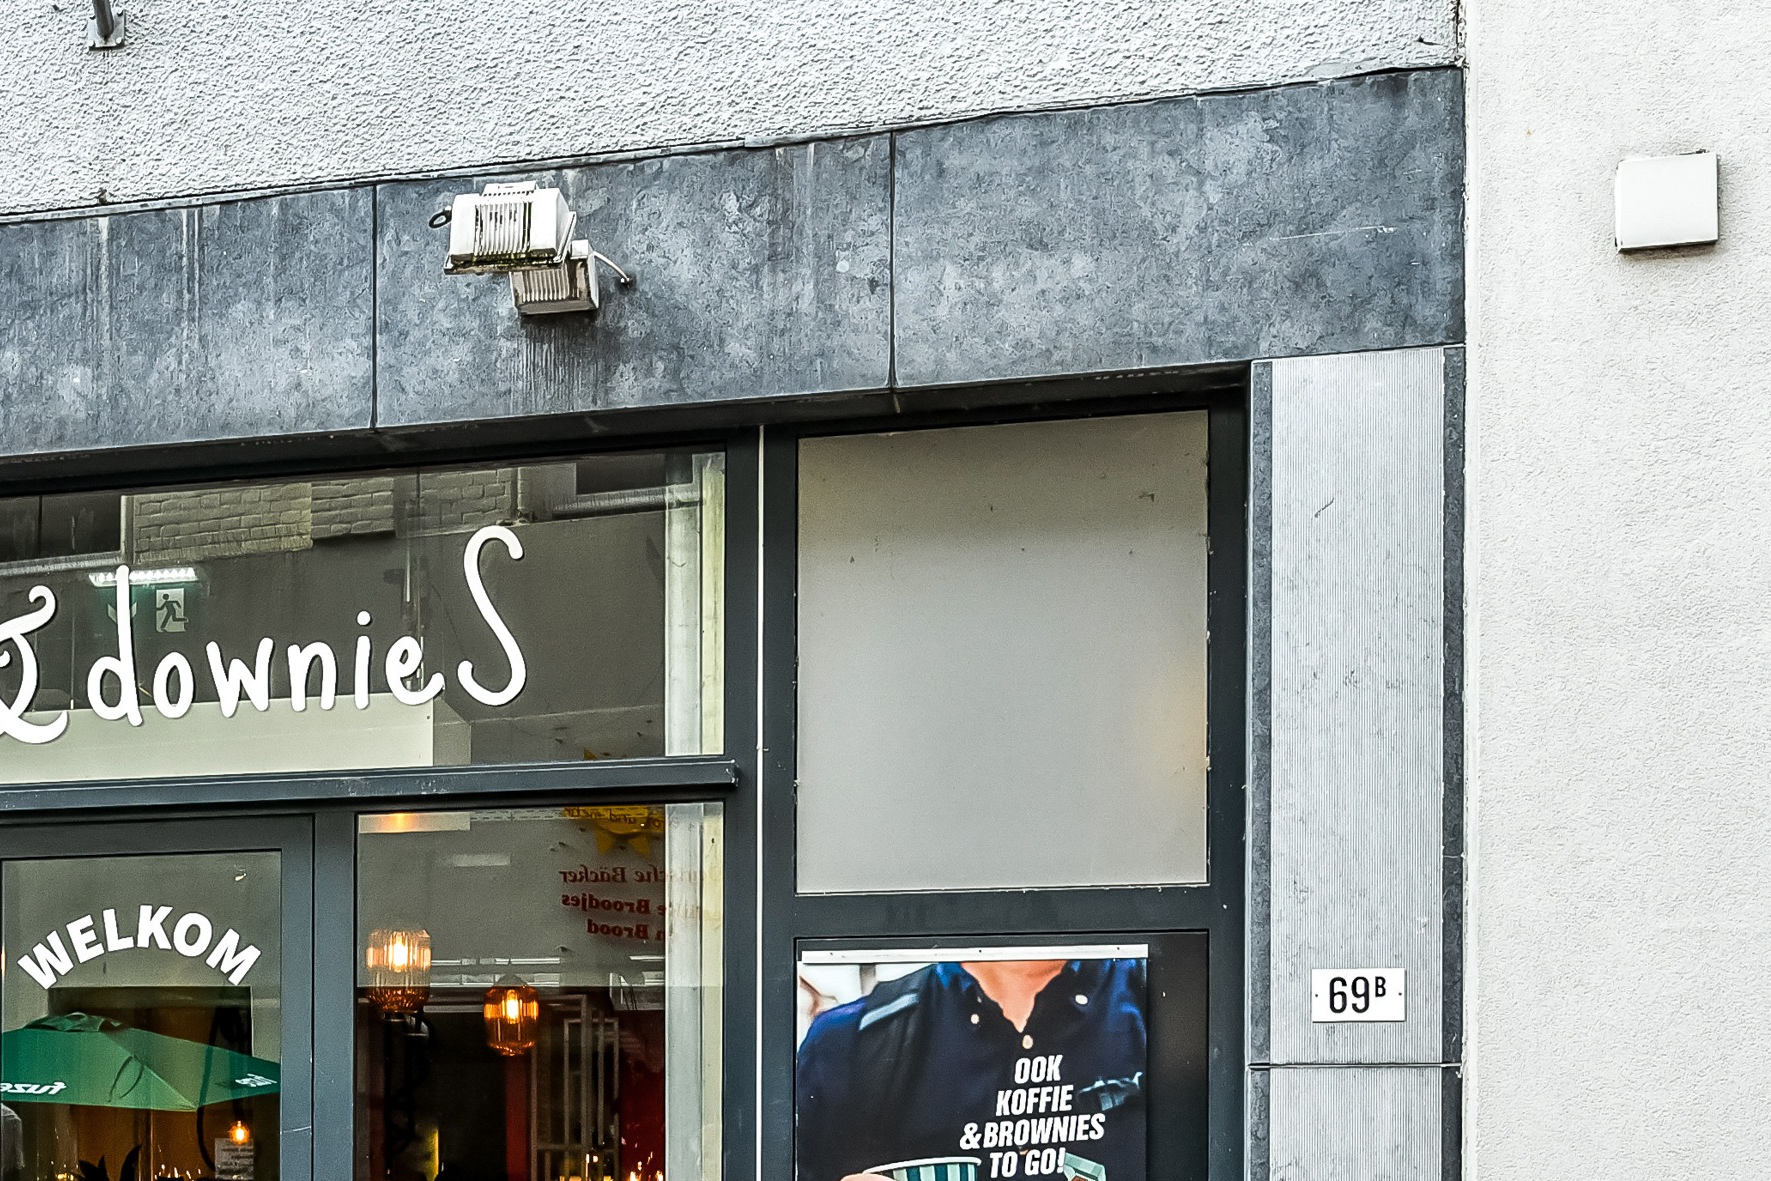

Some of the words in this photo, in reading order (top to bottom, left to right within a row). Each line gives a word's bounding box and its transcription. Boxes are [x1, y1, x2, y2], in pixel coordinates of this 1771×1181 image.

[87, 525, 525, 727] downieS
[17, 904, 262, 990] WELKOM
[1014, 1054, 1064, 1084] OOK
[995, 1084, 1074, 1117] KOFFIE
[989, 1151, 1018, 1179] TO
[1024, 1147, 1066, 1176] GO!
